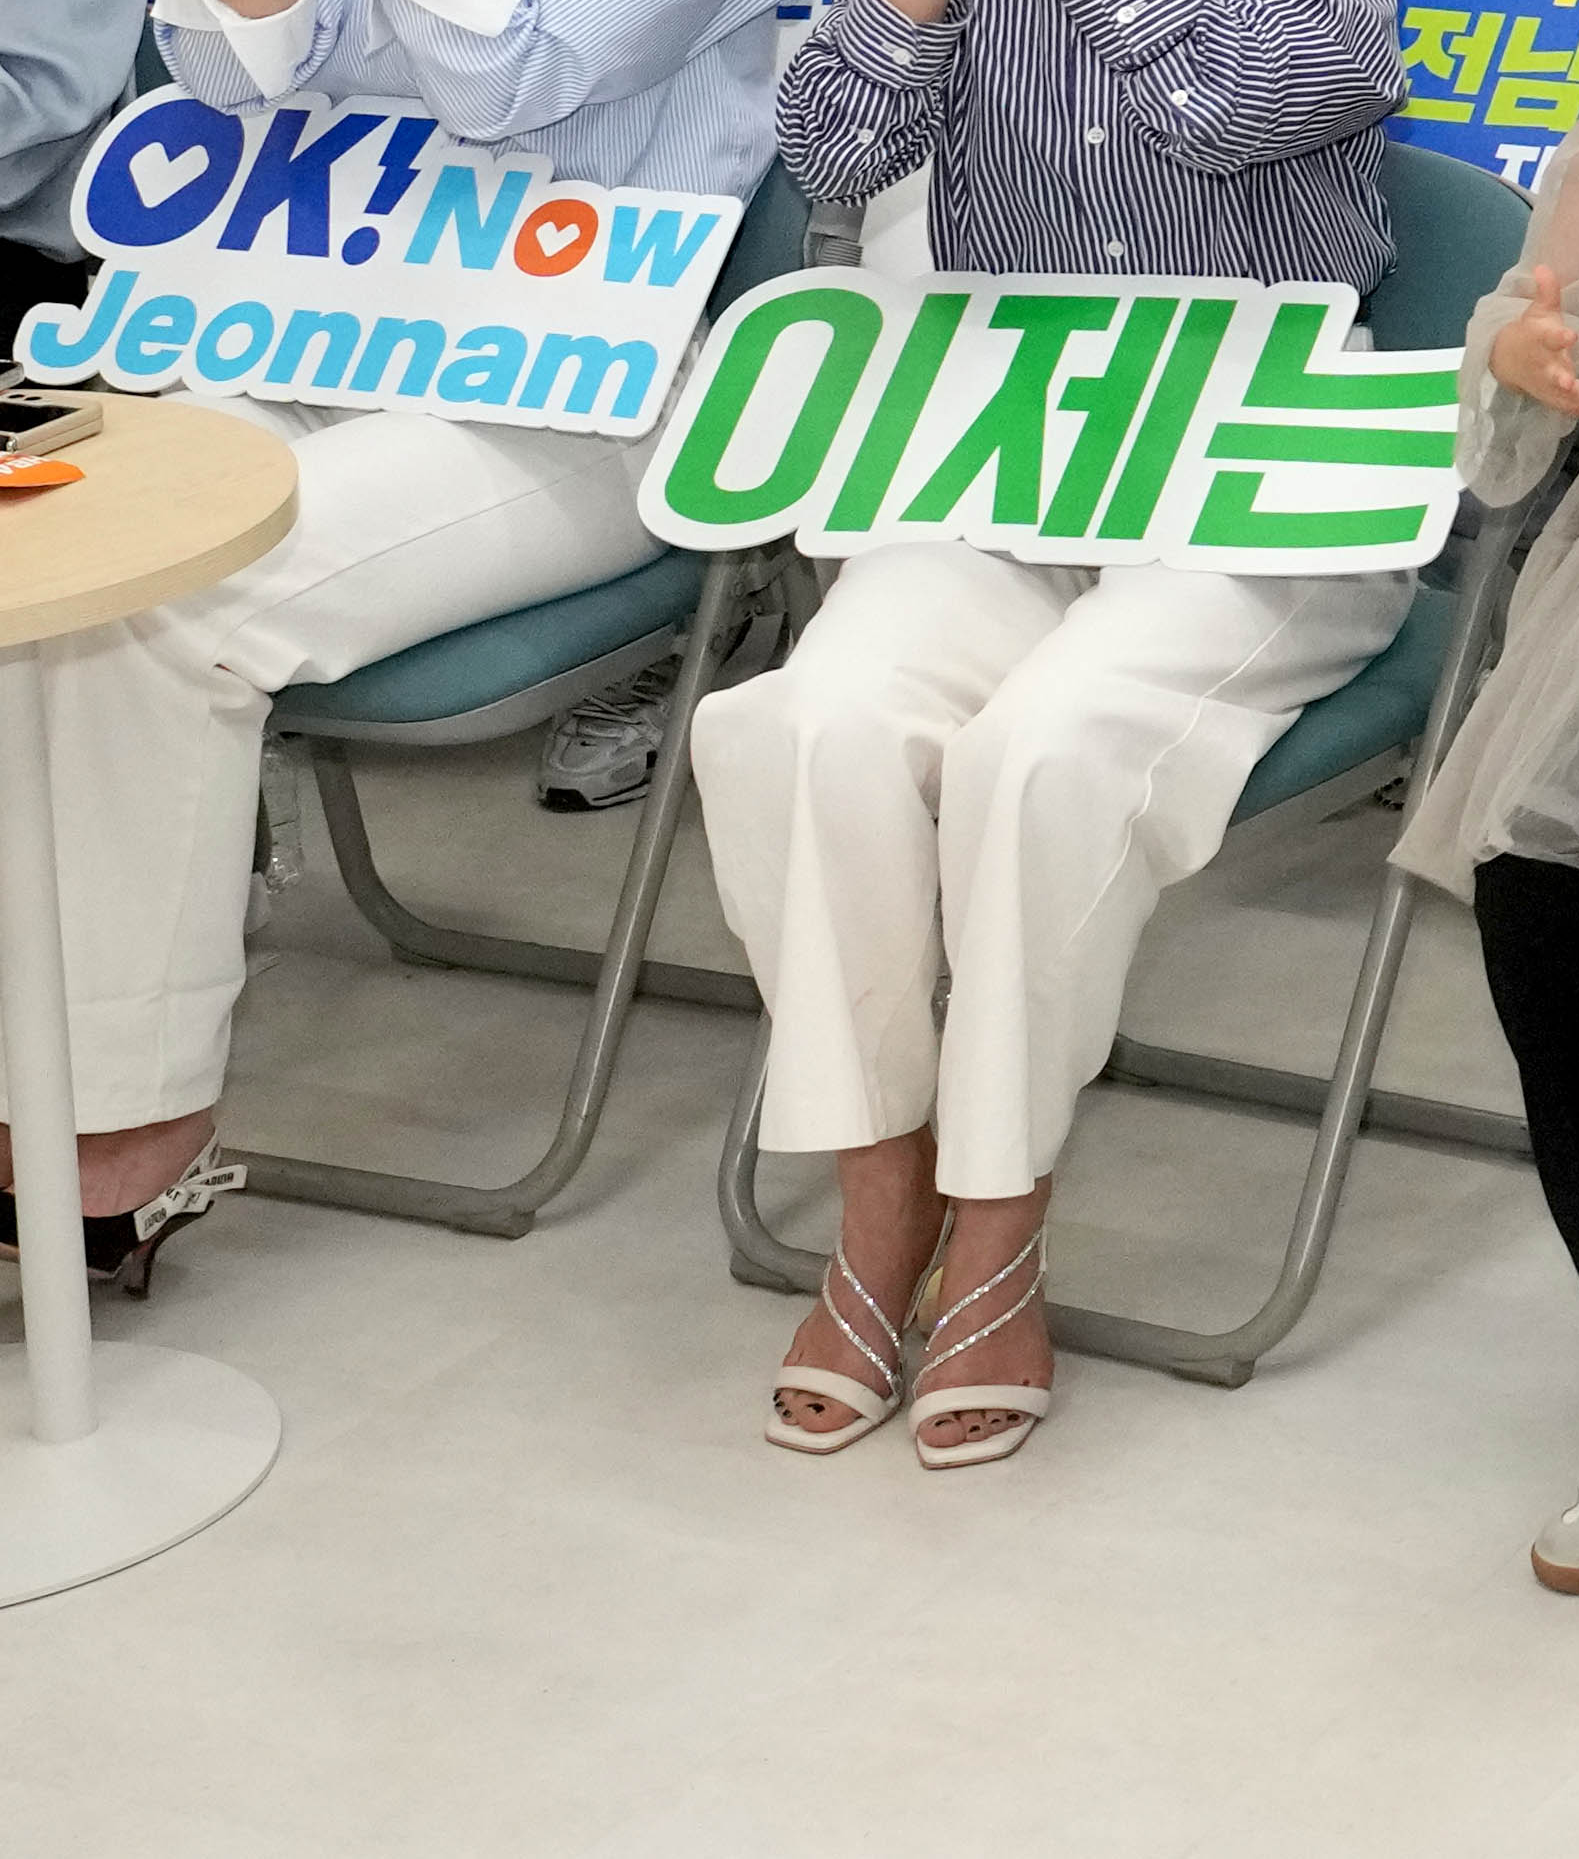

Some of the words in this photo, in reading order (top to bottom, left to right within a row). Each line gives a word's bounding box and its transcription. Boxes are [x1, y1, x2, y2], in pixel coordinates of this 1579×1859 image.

[86, 97, 439, 266] OK!
[402, 164, 719, 288] Now
[28, 269, 659, 420] Jeonnam
[663, 288, 1462, 547] 이제는
